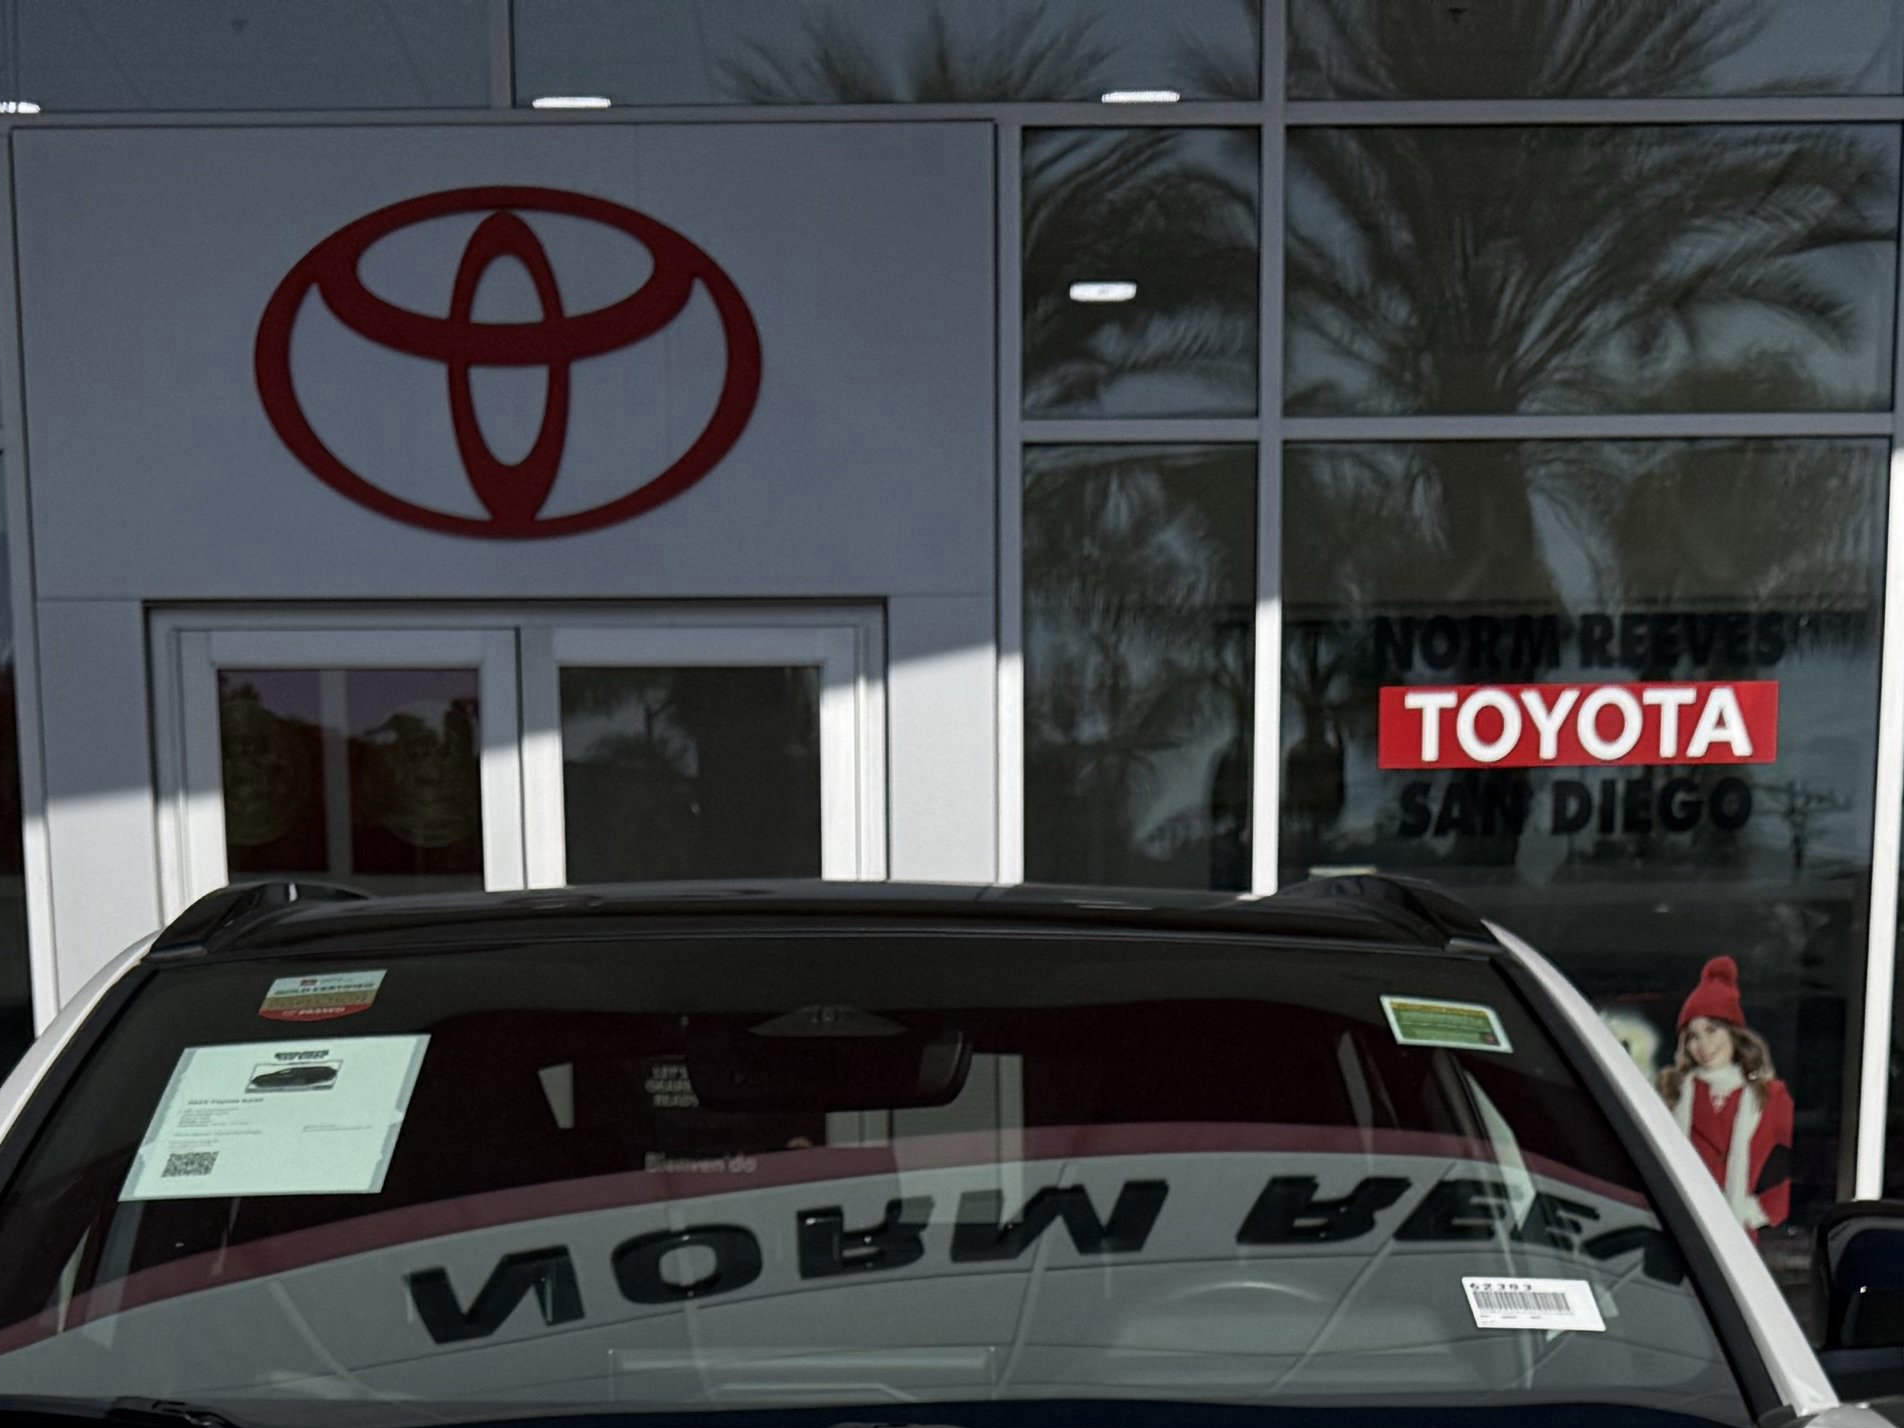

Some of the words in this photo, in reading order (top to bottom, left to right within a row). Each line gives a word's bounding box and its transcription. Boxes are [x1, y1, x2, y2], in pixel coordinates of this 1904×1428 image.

[1373, 615, 1562, 671] NORM
[1580, 612, 1788, 667] REEVES
[1404, 687, 1753, 763] TOYOTA
[1398, 780, 1528, 837] SAN
[1551, 776, 1754, 835] DIEGO
